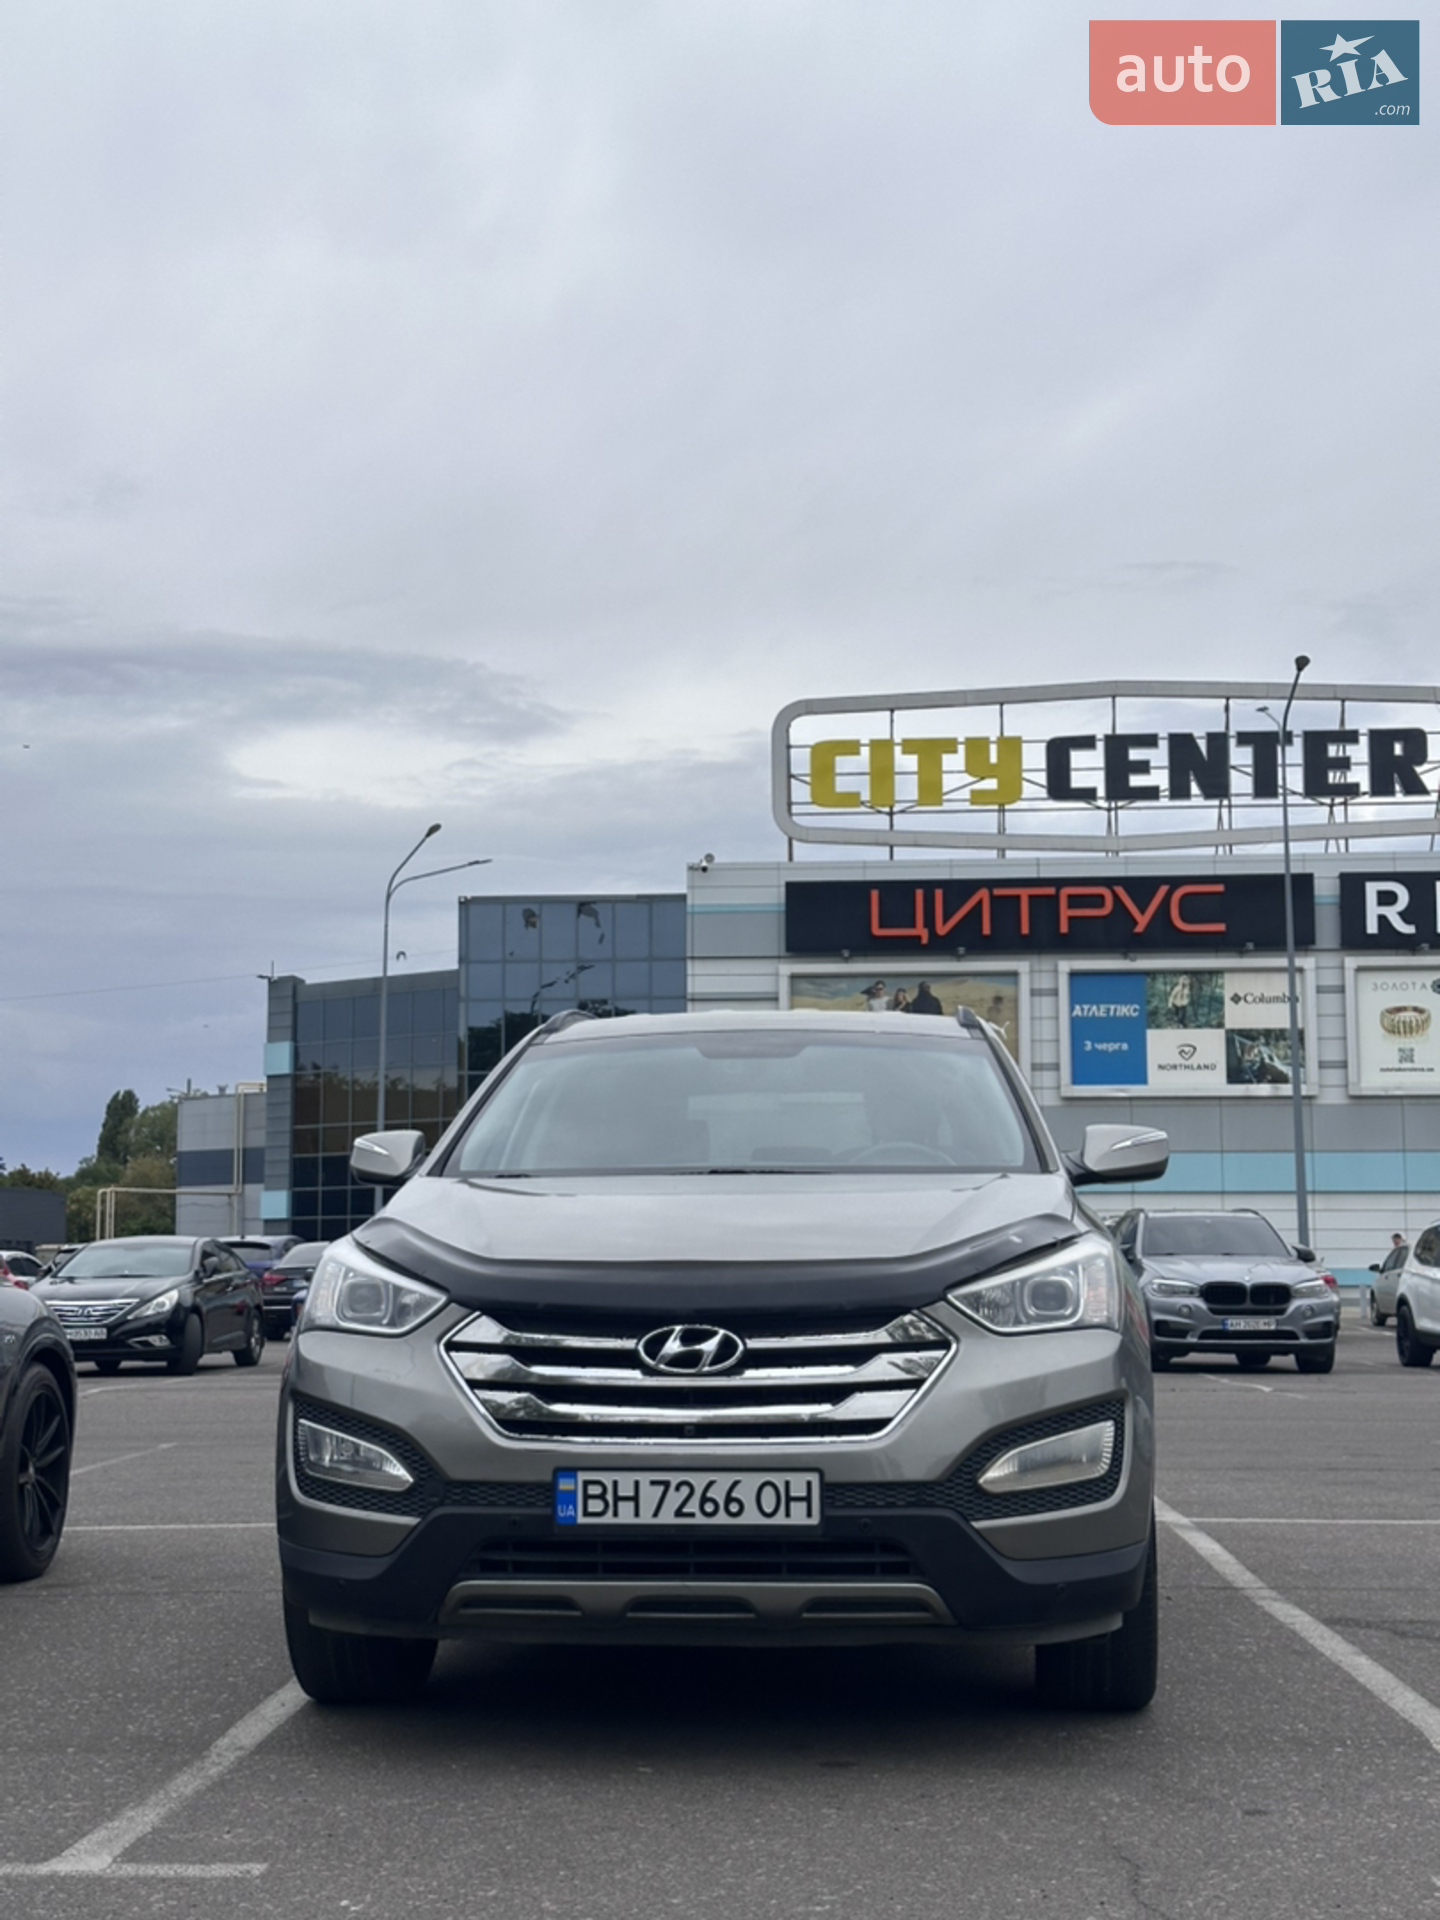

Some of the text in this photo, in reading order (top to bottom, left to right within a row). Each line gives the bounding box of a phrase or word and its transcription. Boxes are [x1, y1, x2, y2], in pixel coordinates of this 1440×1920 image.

[810, 727, 1430, 809] CITY CENTER
[868, 883, 1228, 946] ЦИТРУС
[1364, 880, 1440, 935] R
[1095, 1041, 1128, 1053] черга
[1157, 1063, 1217, 1072] NORTHLAND
[558, 1504, 575, 1517] UA
[582, 1479, 813, 1519] BH 7266 OH
